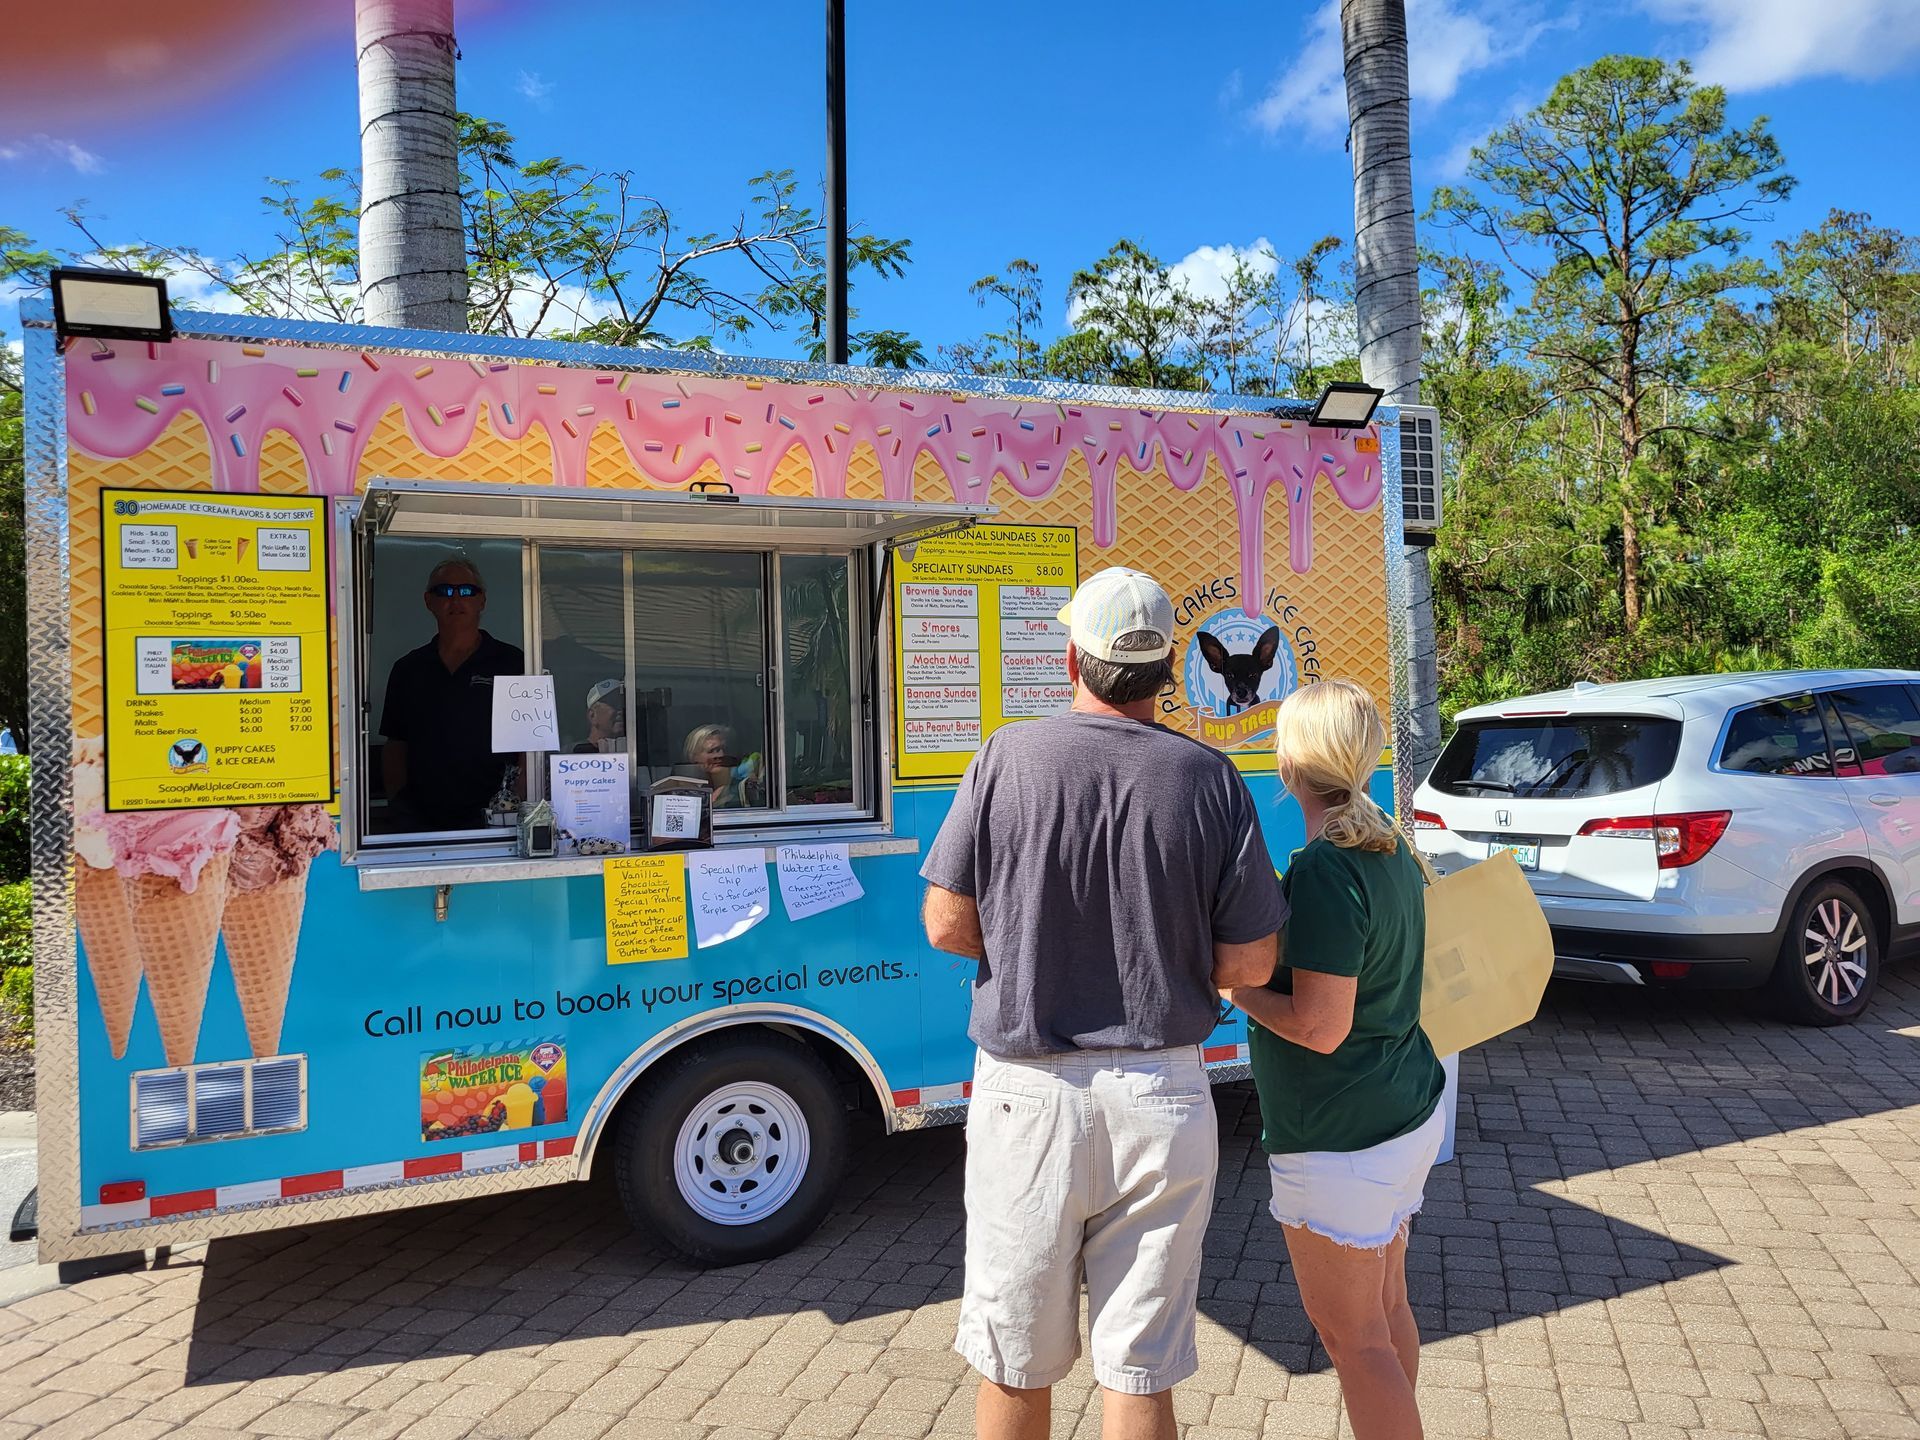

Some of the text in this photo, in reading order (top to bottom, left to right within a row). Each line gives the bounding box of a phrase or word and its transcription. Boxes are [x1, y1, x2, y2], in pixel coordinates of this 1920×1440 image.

[115, 499, 139, 515] 30
[203, 505, 229, 514] CREAM
[232, 508, 264, 518] FLAVORS
[293, 511, 313, 519] SERVE
[937, 530, 1070, 543] DITIONAL SUNDAES $7.00
[912, 563, 1063, 576] SPECIALTY SUNDAES $8.00
[177, 575, 217, 583] Toppings
[906, 586, 973, 595] Brownie Sundae
[1025, 587, 1046, 596] PB&J
[1174, 577, 1237, 626] CAKES
[171, 610, 266, 619] Toppings $0.50ea
[922, 622, 960, 632] S'mores
[1025, 621, 1048, 631] Turtle
[1267, 587, 1321, 687] ICE CREA
[914, 654, 969, 664] Mocha Mud
[1004, 655, 1033, 665] Cookies
[907, 686, 976, 699] Banana Sundae
[1003, 687, 1072, 698] "C" is for Cookie
[906, 721, 979, 732] Club Peanut Butter
[1205, 710, 1279, 741] PUP TREA
[215, 745, 276, 754] PUPPY CAKES
[241, 756, 275, 765] CREAM
[558, 758, 625, 774] Scoop's
[158, 781, 285, 794] ScoopMeUpIceCream.com
[781, 848, 842, 861] Philadelphia
[701, 864, 758, 876] Special Mint
[783, 864, 840, 872] Water Ice
[622, 870, 663, 880] Vanilla
[621, 880, 669, 888] Chocolate
[719, 877, 741, 886] Chip
[621, 886, 669, 897] Strawberry
[702, 892, 710, 900] C
[726, 889, 740, 900] for
[743, 886, 767, 897] Cookie
[614, 895, 683, 908] Special Praline
[700, 904, 728, 915] Purple
[644, 926, 674, 935] Coffee
[618, 945, 672, 957] Butter Pecan
[364, 1007, 423, 1038] Call
[434, 1003, 502, 1032] now
[512, 1000, 544, 1021] to
[556, 984, 631, 1016] book
[641, 979, 703, 1014] your
[711, 965, 808, 1005] special
[448, 1054, 520, 1076] Philadelphia
[448, 1064, 523, 1089] WATER ICE
